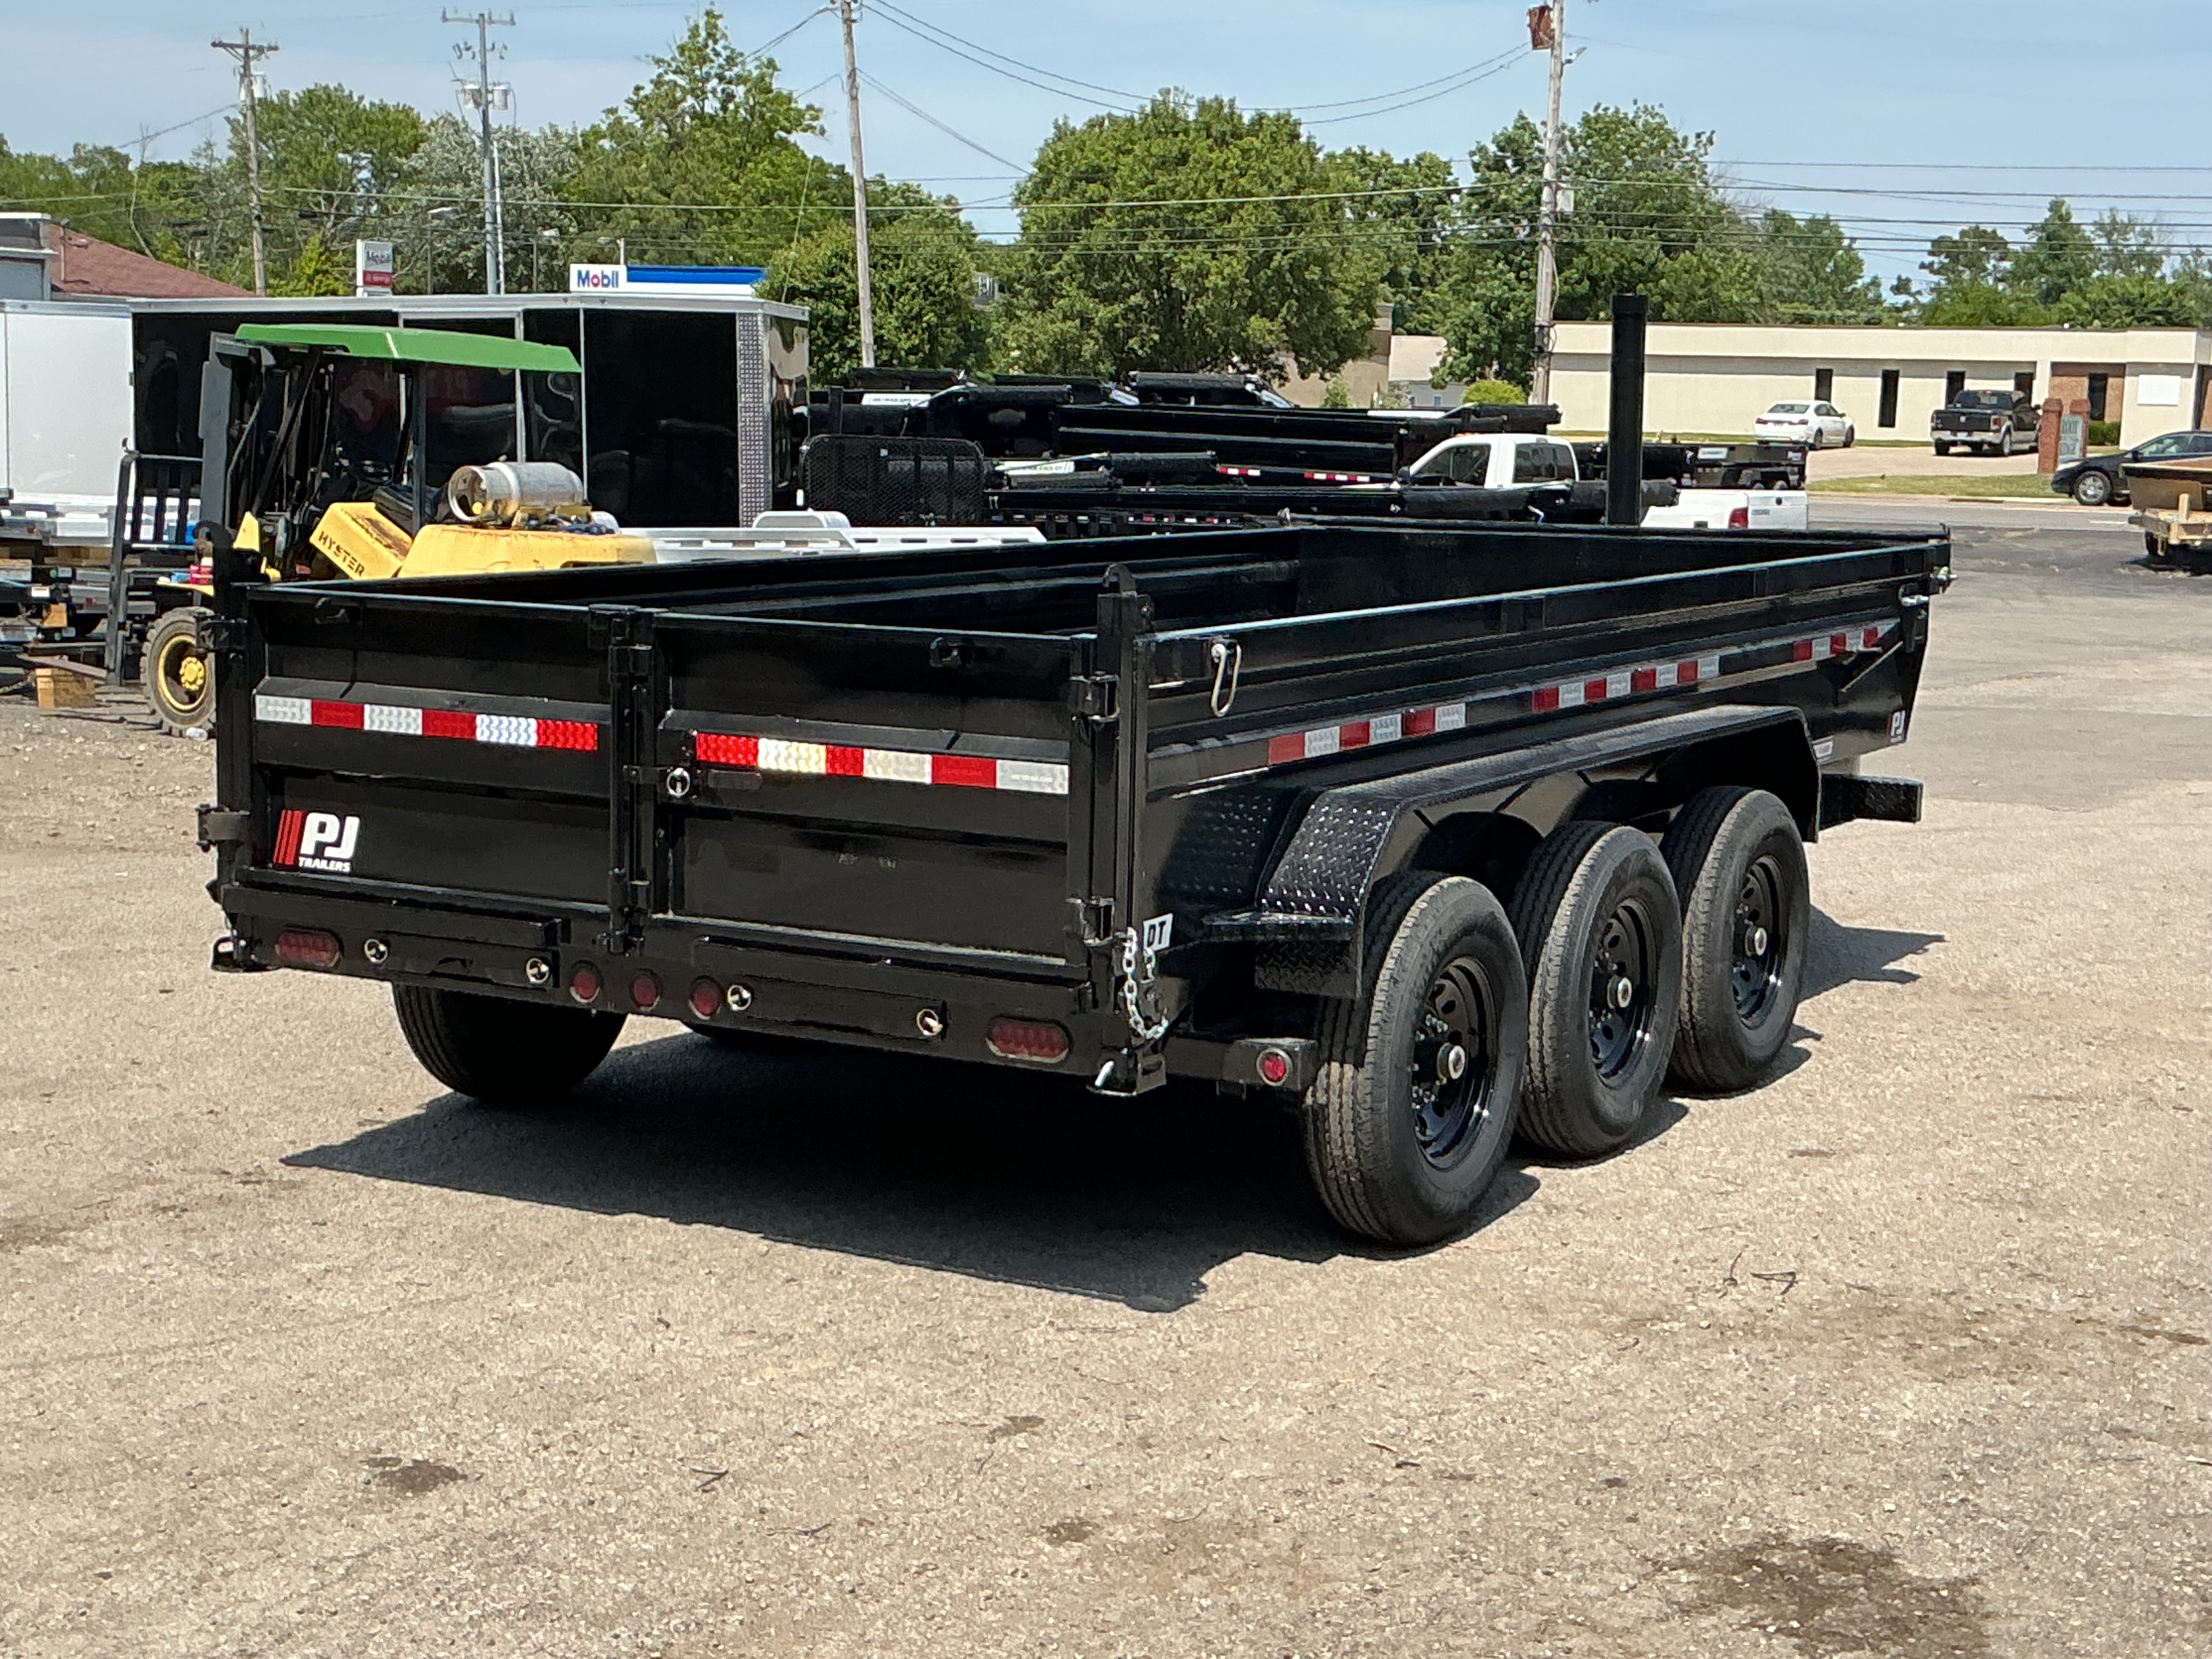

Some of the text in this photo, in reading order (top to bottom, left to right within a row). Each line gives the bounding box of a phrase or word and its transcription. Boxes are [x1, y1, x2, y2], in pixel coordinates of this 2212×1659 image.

[577, 269, 619, 288] Mobil
[318, 531, 365, 577] HYSTER
[1890, 710, 1906, 737] PJ
[300, 812, 360, 859] PJ
[298, 856, 352, 873] TRAILERS
[1147, 919, 1167, 948] DT
